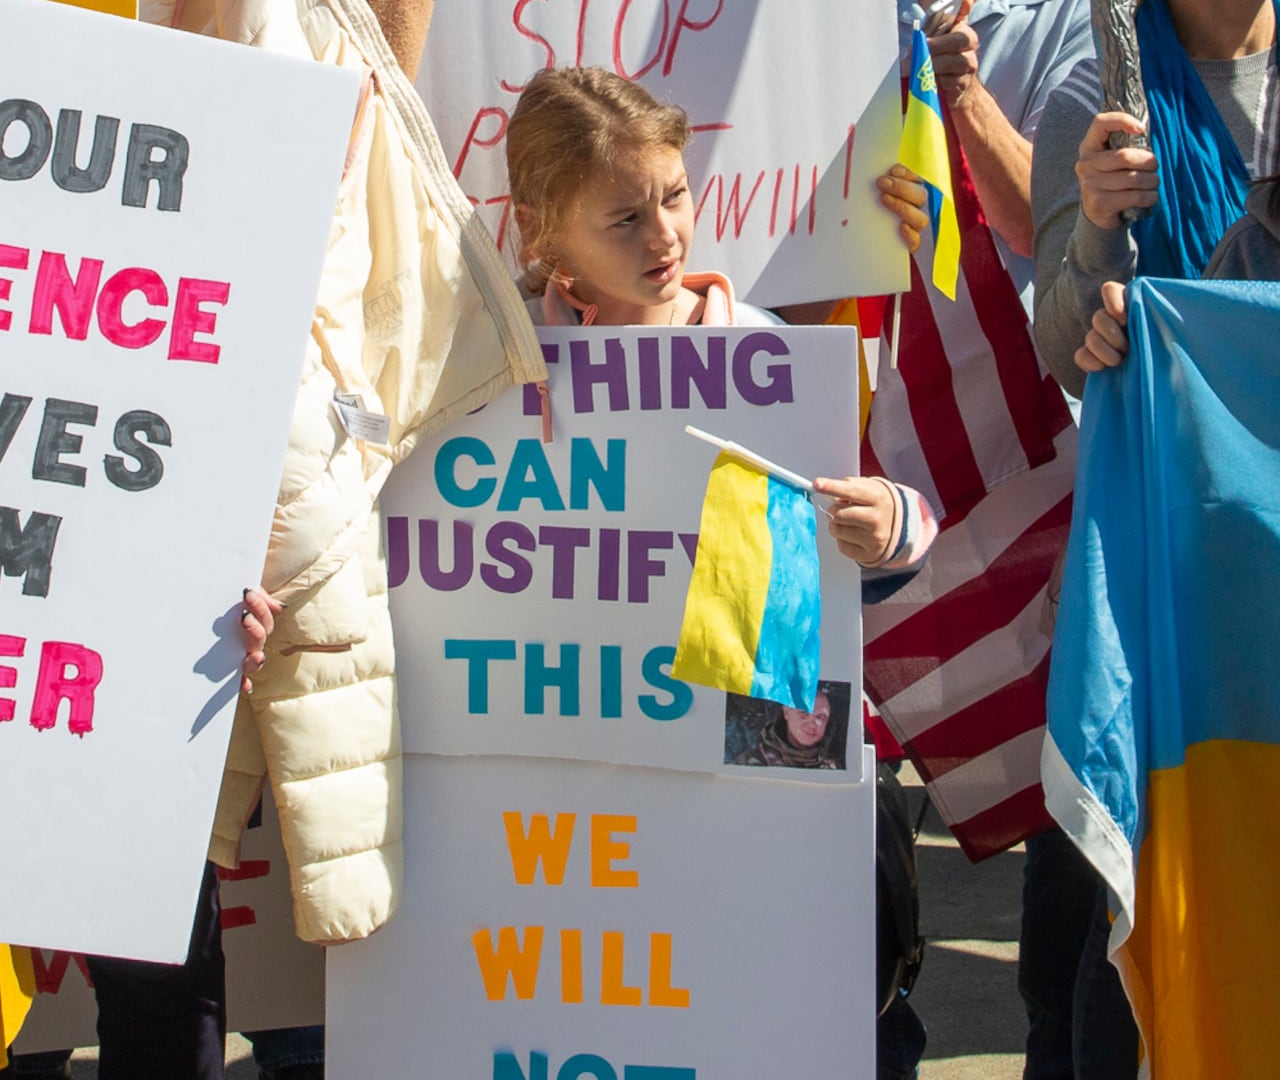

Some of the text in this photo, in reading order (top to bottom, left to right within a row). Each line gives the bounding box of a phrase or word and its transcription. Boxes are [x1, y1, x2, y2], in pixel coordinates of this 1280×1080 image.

[434, 436, 627, 511] CAN
[445, 639, 694, 721] THIS
[502, 811, 639, 888] WE
[472, 926, 690, 1009] WILL
